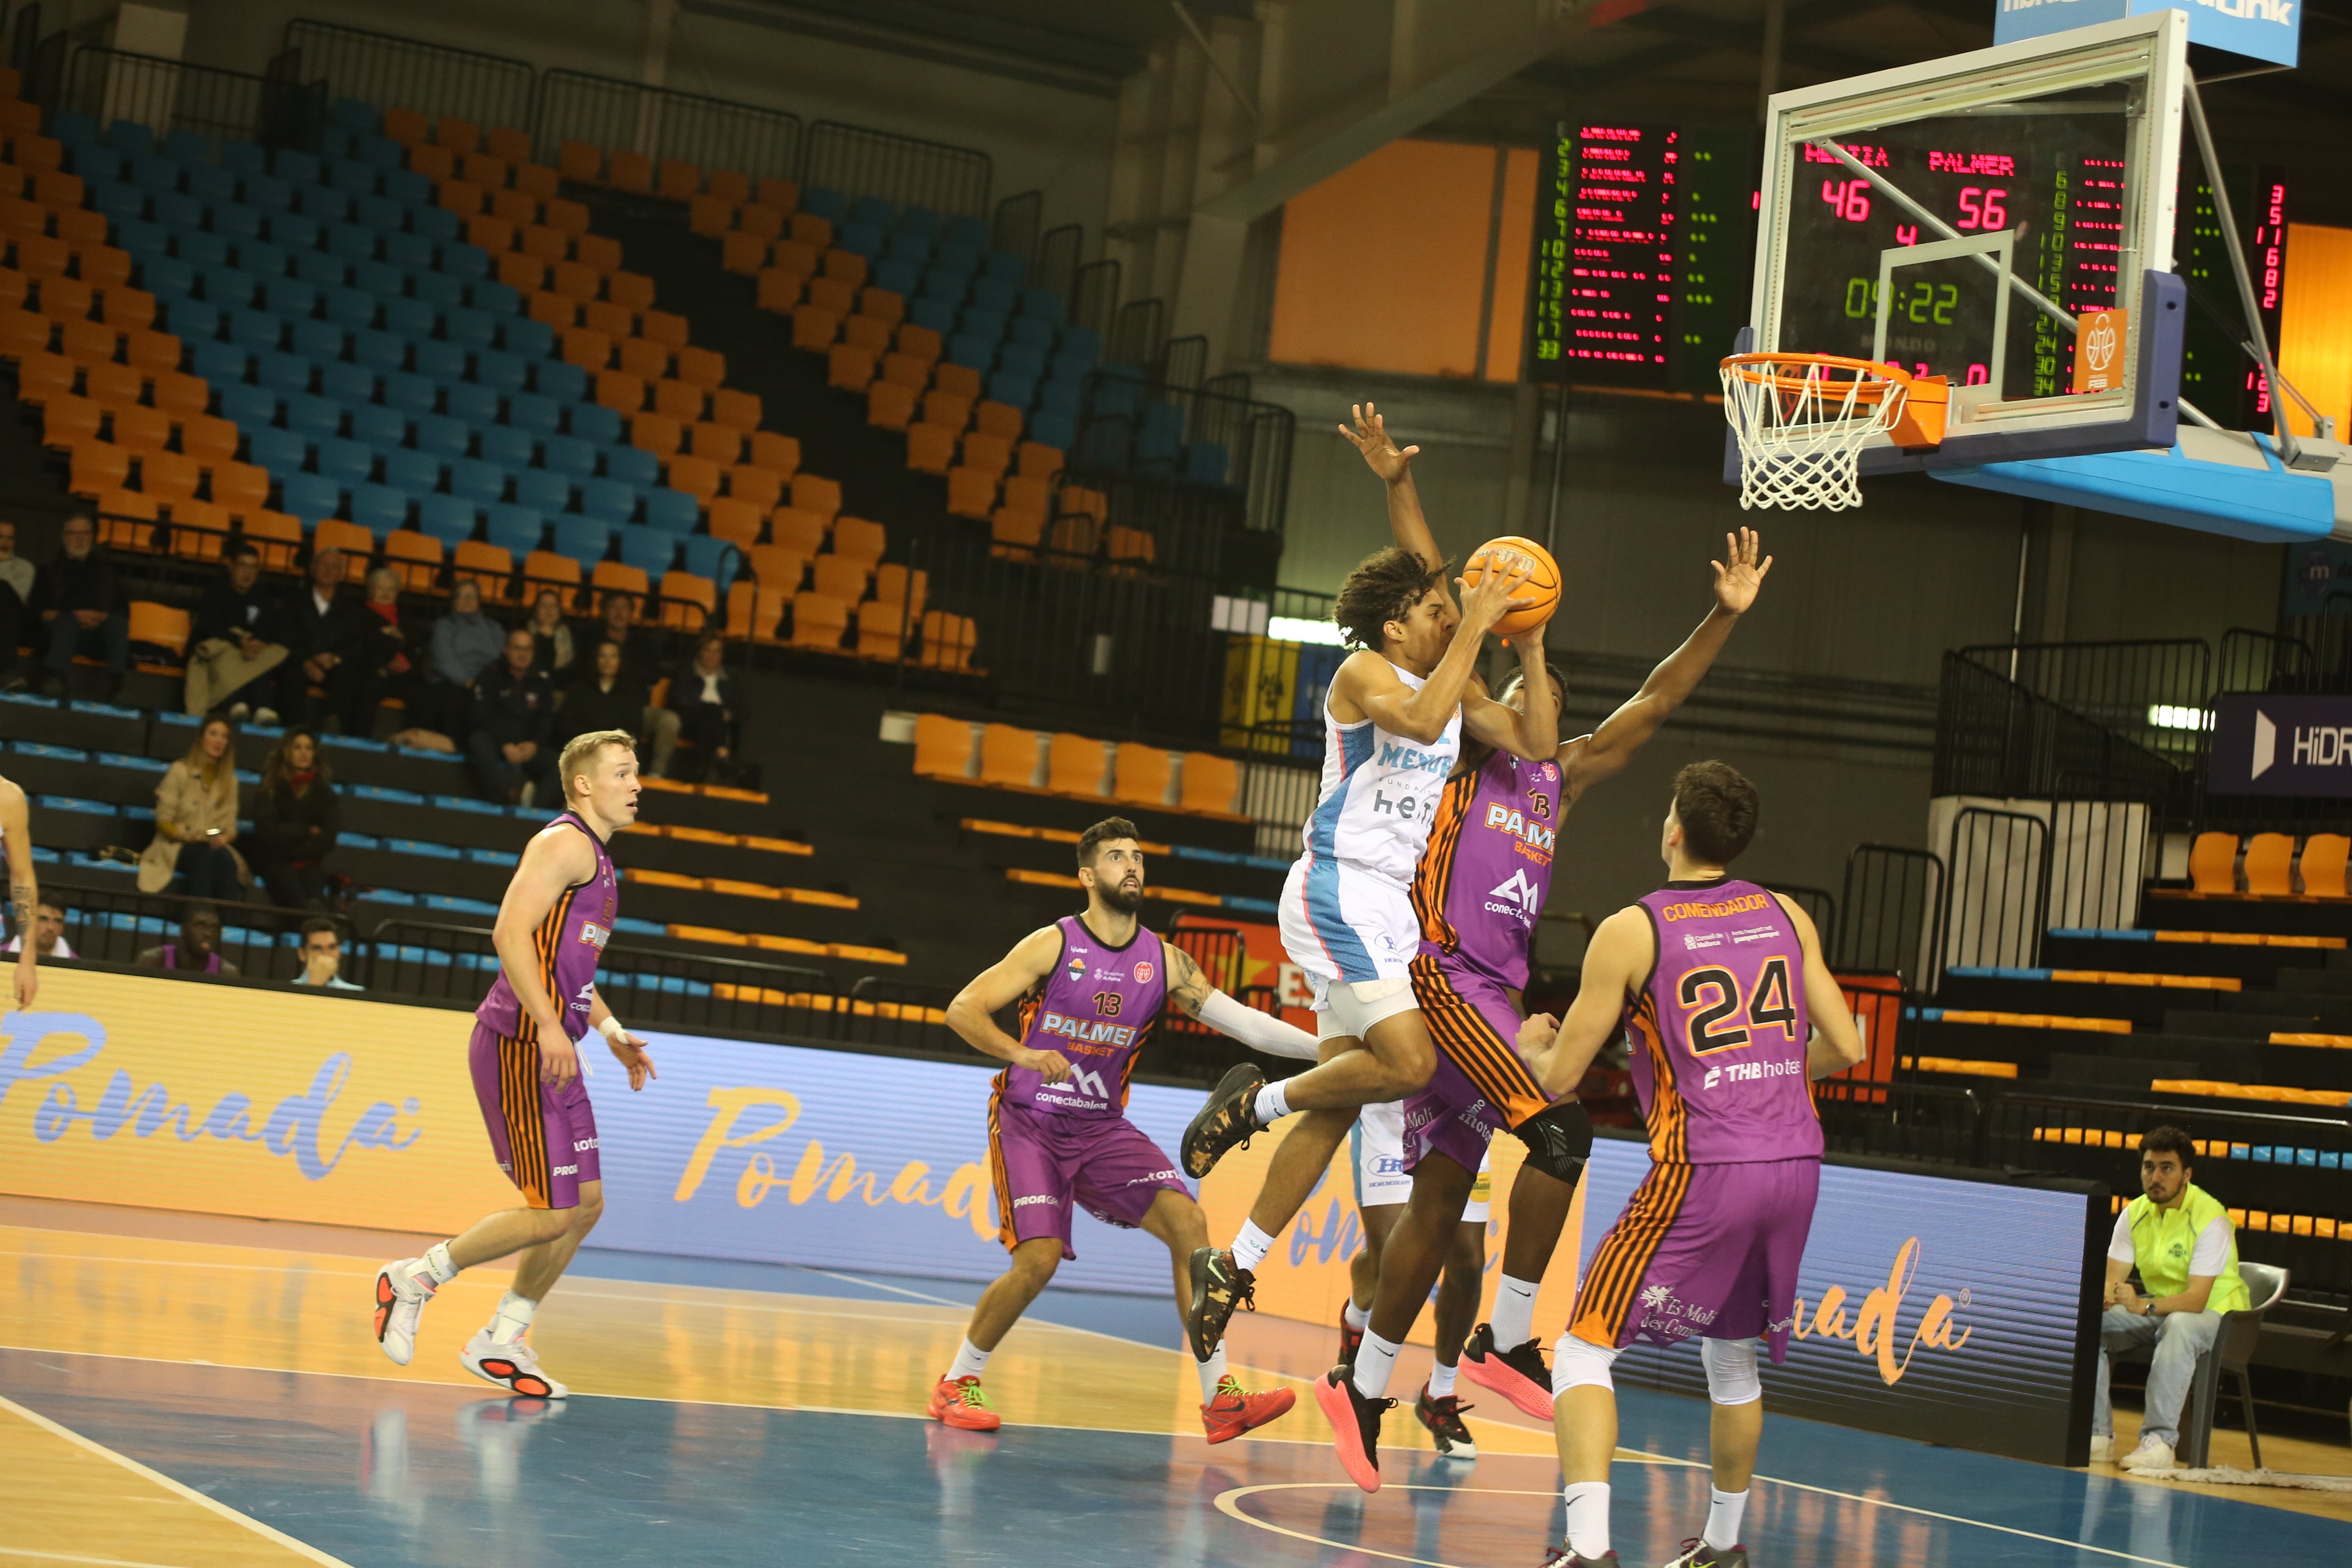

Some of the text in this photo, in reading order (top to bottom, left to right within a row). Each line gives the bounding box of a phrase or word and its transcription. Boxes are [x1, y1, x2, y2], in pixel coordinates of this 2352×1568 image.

[1557, 138, 1572, 158] 2
[1558, 158, 1570, 178] 3
[1929, 151, 2014, 176] PALMER
[1556, 179, 1569, 197] 4
[2056, 170, 2067, 189] 6
[1822, 180, 1871, 222] 46
[2054, 191, 2066, 209] 8
[2271, 185, 2284, 204] 3
[1554, 199, 1567, 218] 6
[1957, 188, 2007, 230] 56
[2270, 206, 2282, 225] 5
[1556, 219, 1567, 238] 7
[2054, 212, 2066, 231] 9
[2040, 232, 2064, 251] 10
[2257, 226, 2282, 246] 11
[1542, 239, 1566, 258] 10
[2266, 247, 2279, 267] 6
[1541, 259, 1565, 279] 12
[2039, 253, 2063, 272] 13
[2038, 273, 2061, 292] 15
[2265, 269, 2279, 287] 8
[1540, 279, 1564, 299] 13
[1845, 278, 1958, 325] 09:22
[2264, 289, 2278, 309] 2
[1539, 300, 1562, 319] 15
[1537, 320, 1562, 339] 17
[2035, 335, 2058, 354] 24
[2034, 355, 2056, 375] 30
[2034, 376, 2055, 396] 34
[2088, 379, 2107, 389] FEB
[1662, 894, 1769, 922] COMENDADOR
[1092, 991, 1123, 1016] 13
[1676, 955, 1797, 1057] 24
[1066, 1042, 1114, 1058] BASKET
[0, 1010, 422, 1181] Pomada
[1640, 1312, 1665, 1331] des
[1665, 1298, 1718, 1326] Es Molí
